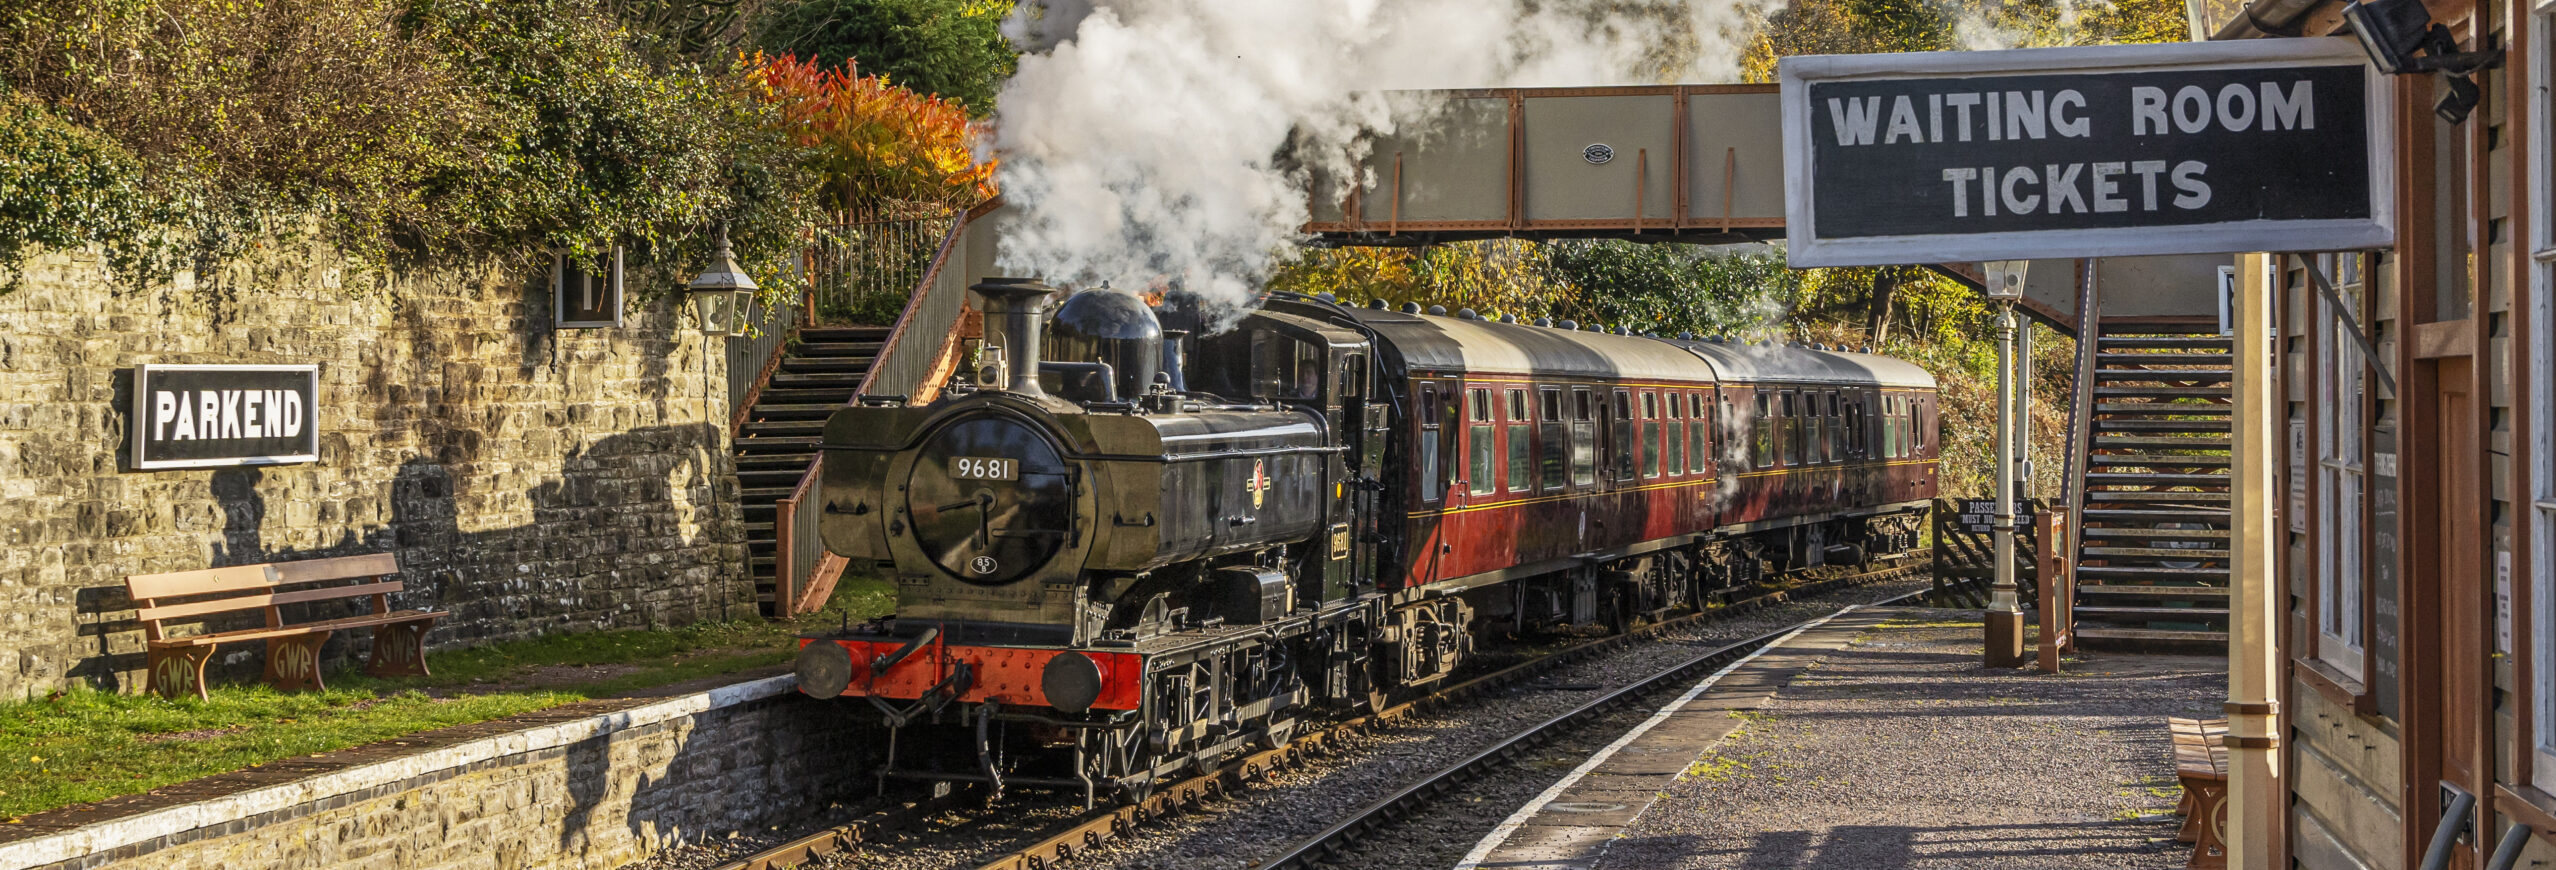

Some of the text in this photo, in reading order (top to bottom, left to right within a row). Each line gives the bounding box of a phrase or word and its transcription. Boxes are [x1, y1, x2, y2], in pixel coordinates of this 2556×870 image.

[1828, 80, 2315, 146] WAITING ROOM
[1942, 160, 2212, 217] TICKETS
[154, 389, 303, 441] PARKEND
[958, 458, 1008, 479] 9681
[1962, 515, 1981, 524] MUST
[1969, 501, 2023, 514] PASSERS
[977, 558, 990, 567] 85
[273, 642, 312, 680] GWR
[381, 627, 418, 663] GWR
[155, 656, 196, 697] GWR
